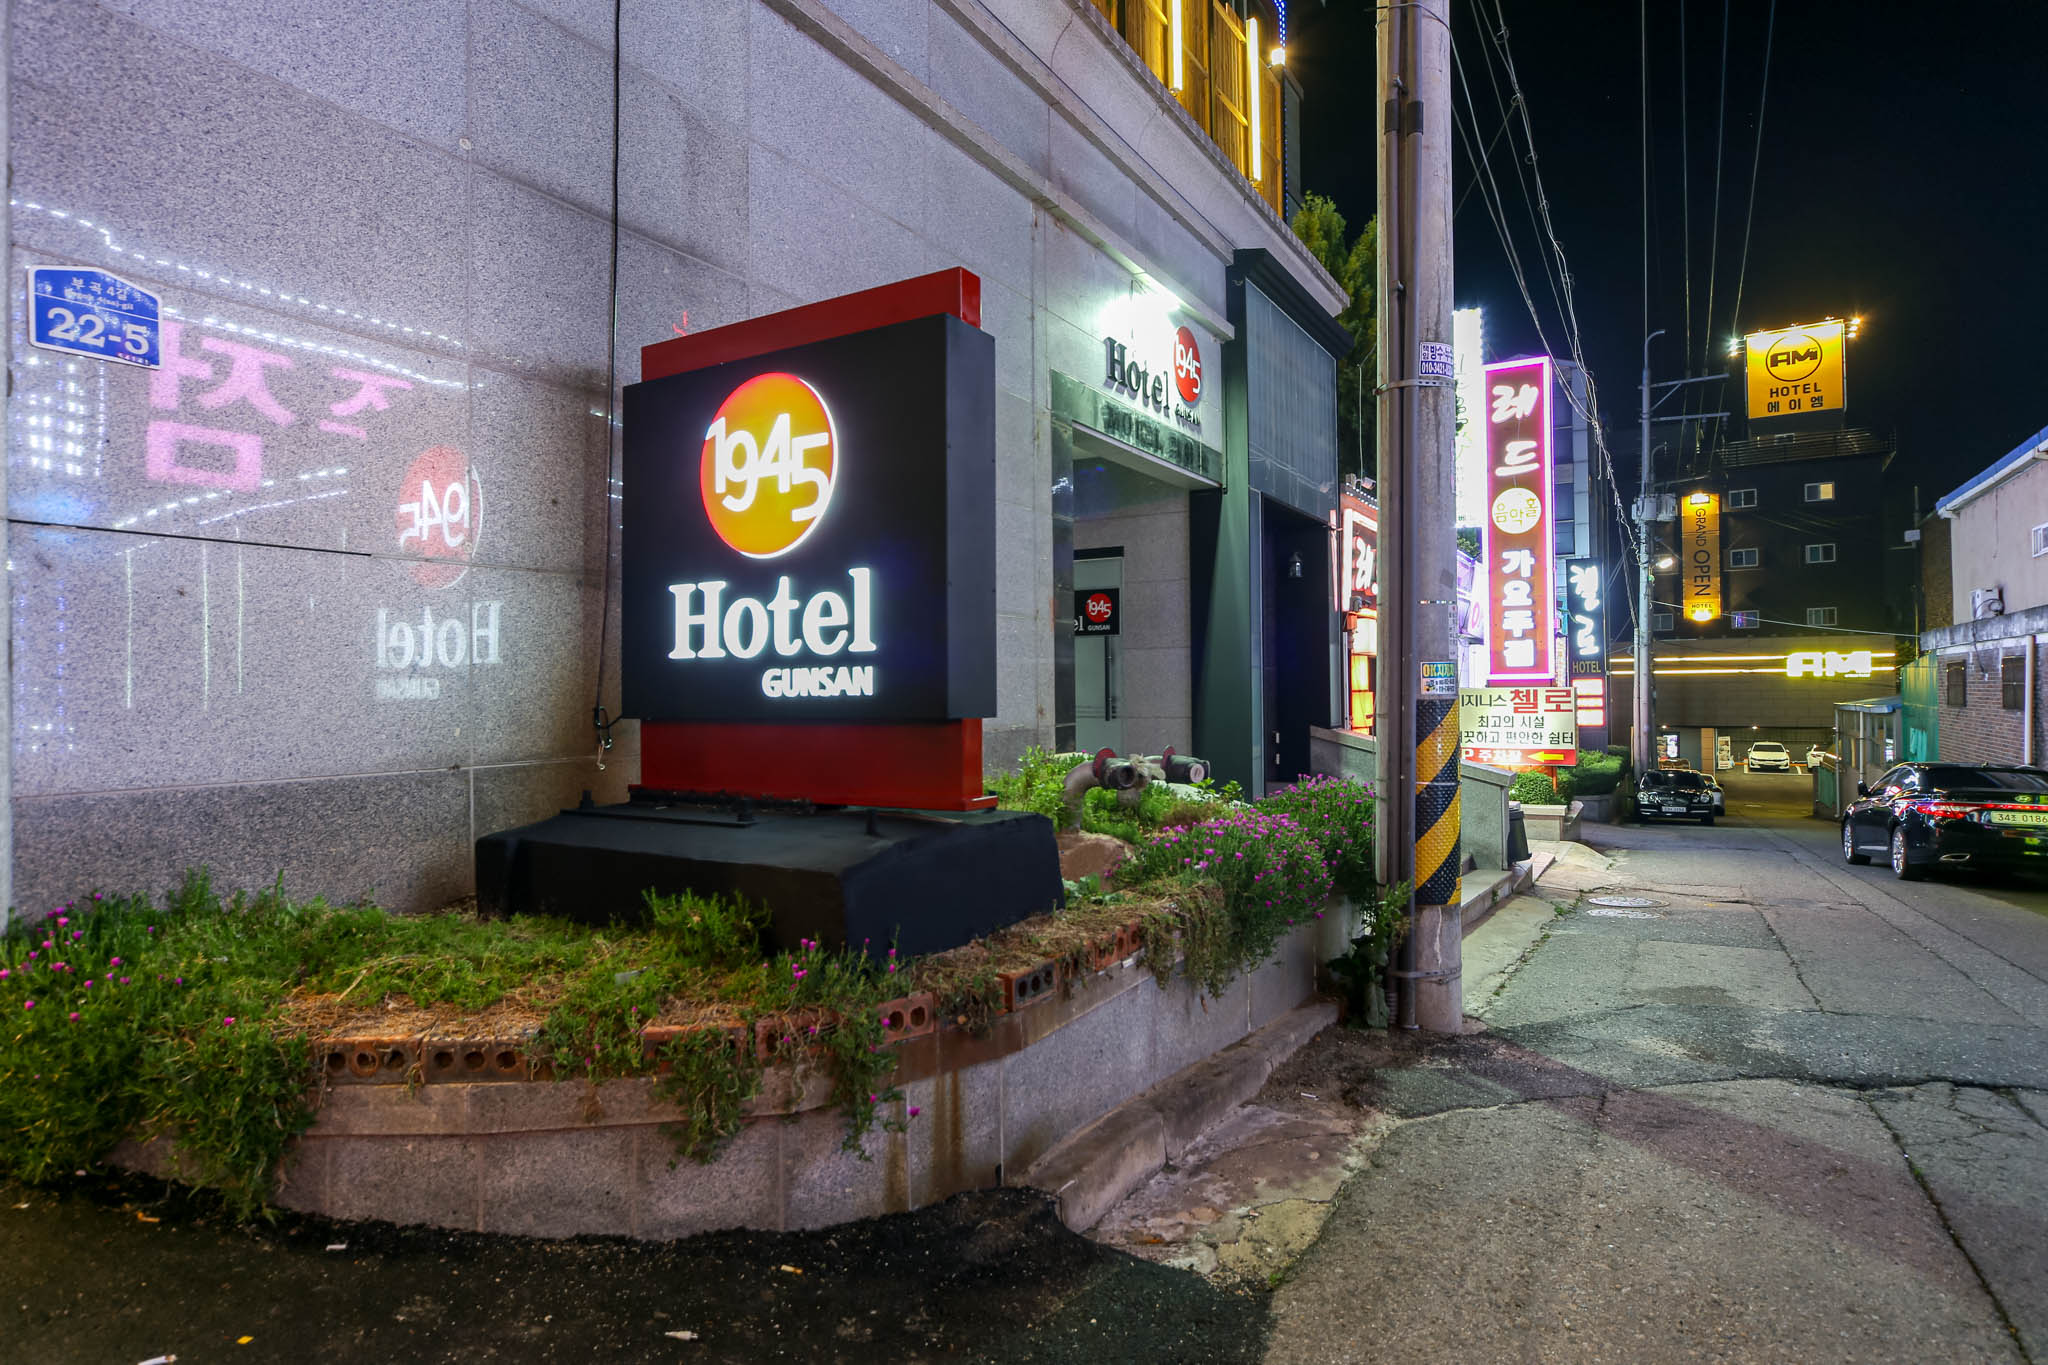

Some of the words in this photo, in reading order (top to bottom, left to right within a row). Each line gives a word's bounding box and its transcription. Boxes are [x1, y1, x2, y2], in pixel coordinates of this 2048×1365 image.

[47, 307, 150, 356] 22-5
[1103, 337, 1171, 410] Hotel
[1175, 336, 1202, 395] 1945
[1769, 382, 1822, 399] HOTEL
[1490, 383, 1541, 478] 레드
[704, 413, 831, 523] 1945
[1495, 497, 1538, 525] 음악홀
[1695, 508, 1707, 547] GRAND
[1693, 550, 1711, 596] OPEN
[667, 567, 878, 660] Hotel
[1086, 599, 1112, 618] 1945
[1501, 549, 1537, 668] 가요주점
[1087, 624, 1111, 632] GUNSAN
[761, 665, 875, 698] GUNSAN
[1572, 660, 1602, 674] HOTEL
[1510, 688, 1574, 714] 첼로
[1460, 731, 1500, 744] 끗하고
[1505, 731, 1544, 745] 편안한
[1548, 731, 1574, 745] 쉼터
[1478, 715, 1515, 729] 최고의
[1520, 715, 1545, 729] 시설
